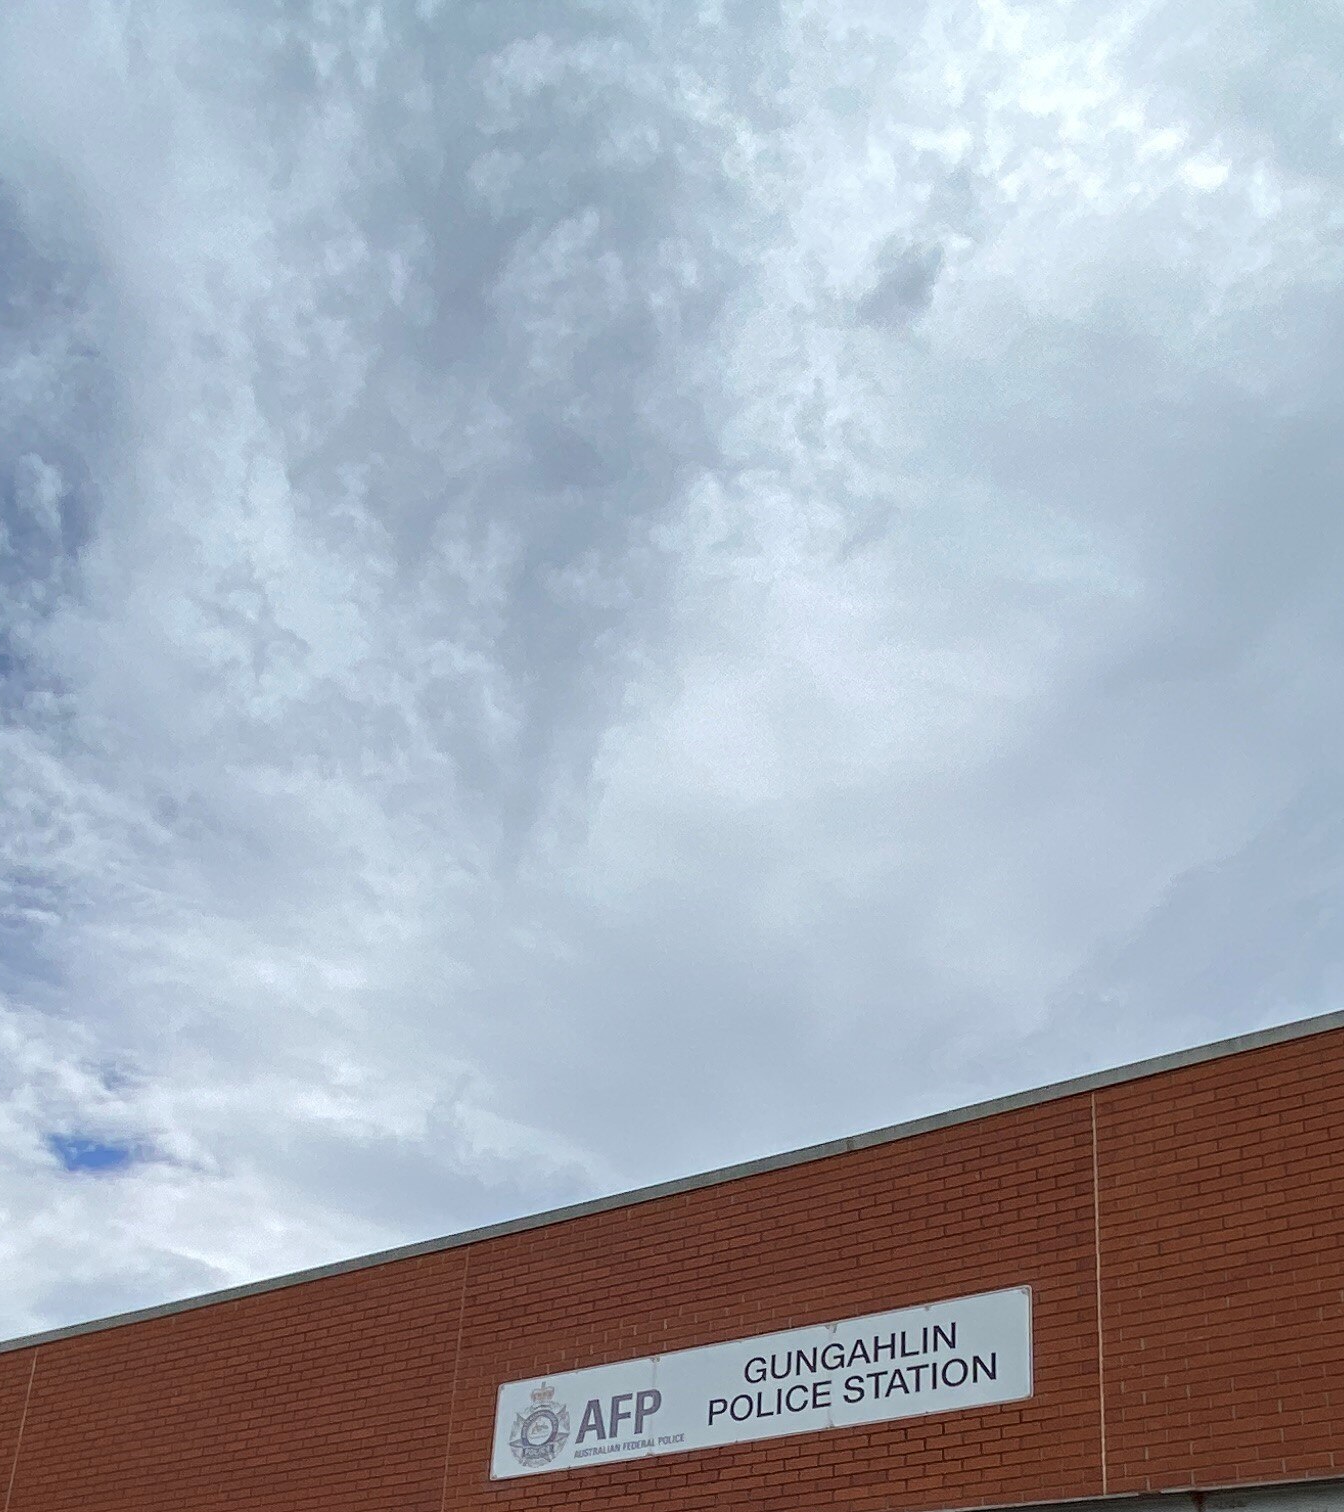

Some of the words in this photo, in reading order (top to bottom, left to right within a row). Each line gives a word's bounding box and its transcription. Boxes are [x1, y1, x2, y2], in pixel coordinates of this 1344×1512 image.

[744, 1322, 958, 1384] GUNGAHLIN
[575, 1389, 662, 1444] AFP
[708, 1379, 832, 1426] POLICE
[842, 1353, 997, 1405] STATION
[574, 1444, 620, 1459] AUSTRALIAN
[623, 1439, 655, 1451] FEDERAL
[658, 1433, 685, 1446] POLICE
